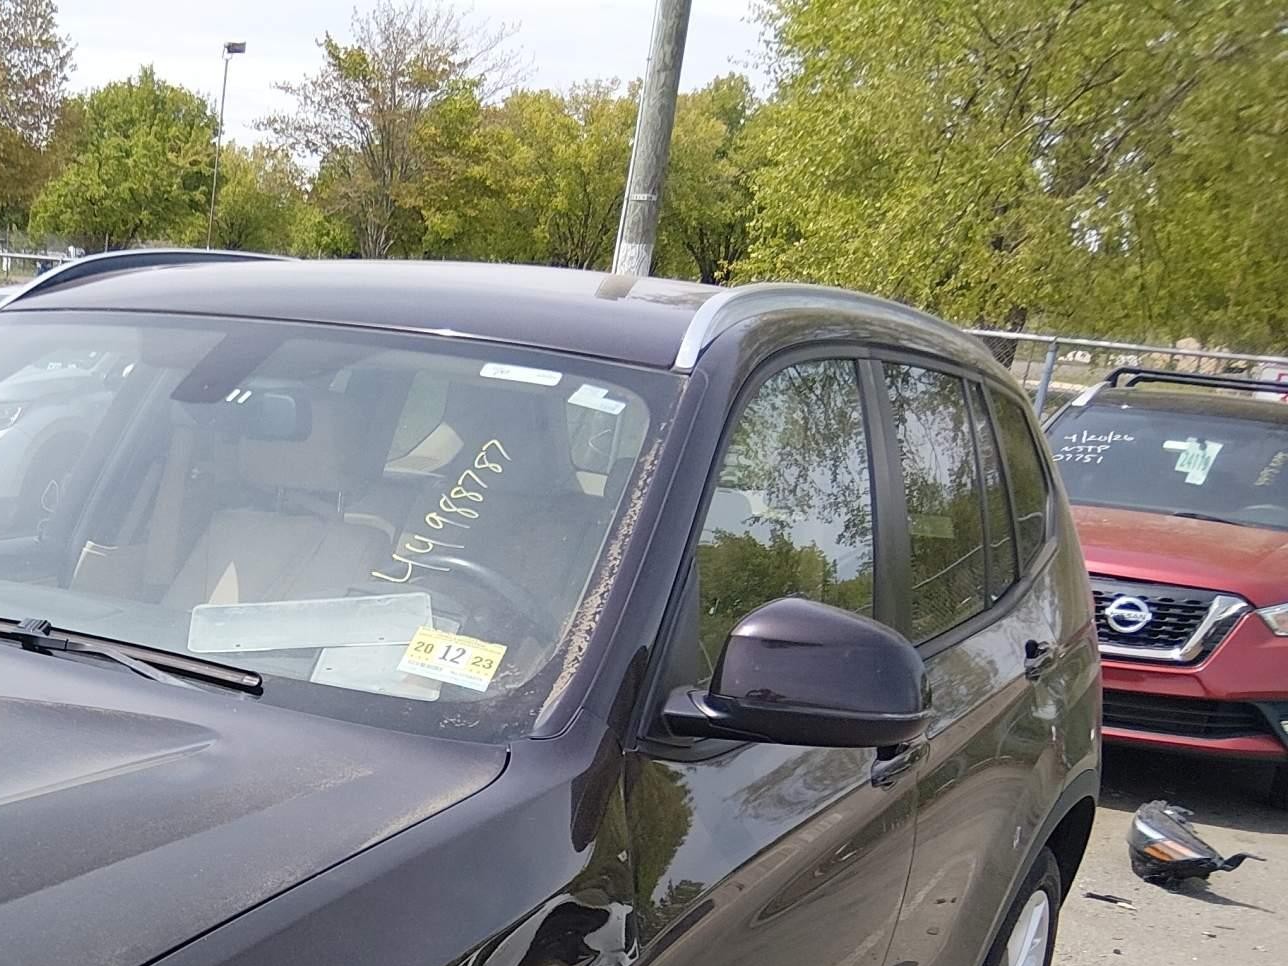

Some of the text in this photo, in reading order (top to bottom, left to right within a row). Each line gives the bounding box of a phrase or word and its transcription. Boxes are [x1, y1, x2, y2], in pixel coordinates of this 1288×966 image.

[372, 439, 512, 582] 44988787
[414, 641, 434, 654] 20
[438, 644, 466, 664] 12
[471, 656, 494, 669] 23
